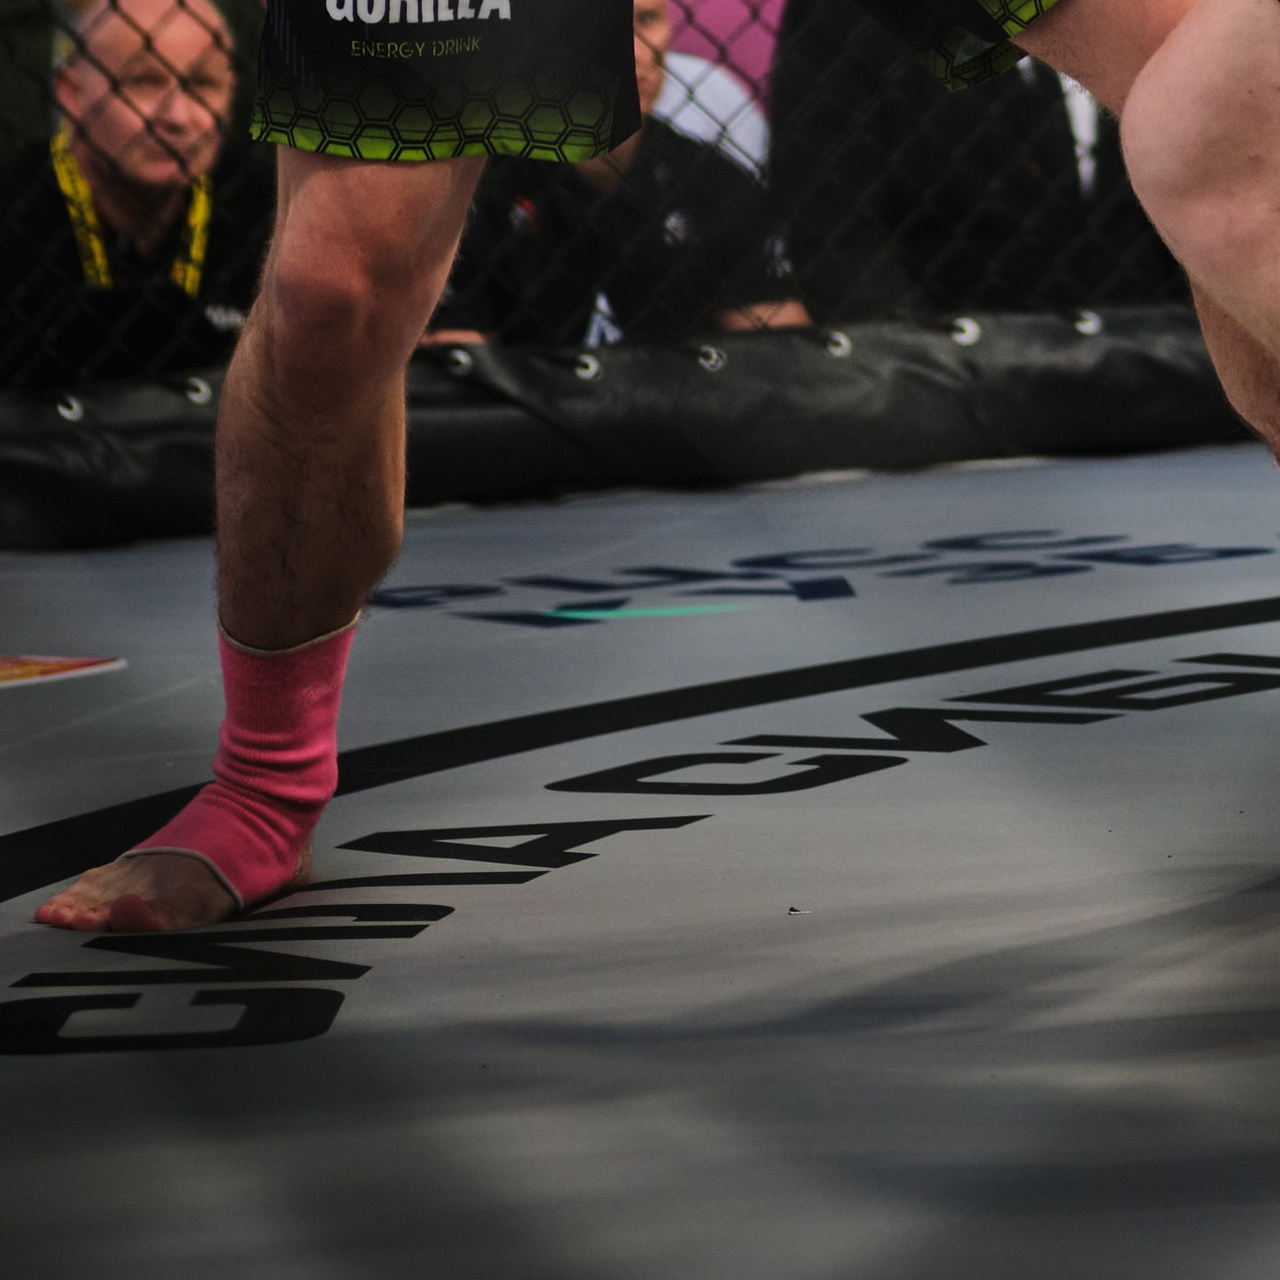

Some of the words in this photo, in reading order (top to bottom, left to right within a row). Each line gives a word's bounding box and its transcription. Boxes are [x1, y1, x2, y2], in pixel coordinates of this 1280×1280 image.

[351, 39, 426, 59] ENERGY
[432, 37, 482, 56] DRINK
[0, 814, 714, 1056] СИЛА
